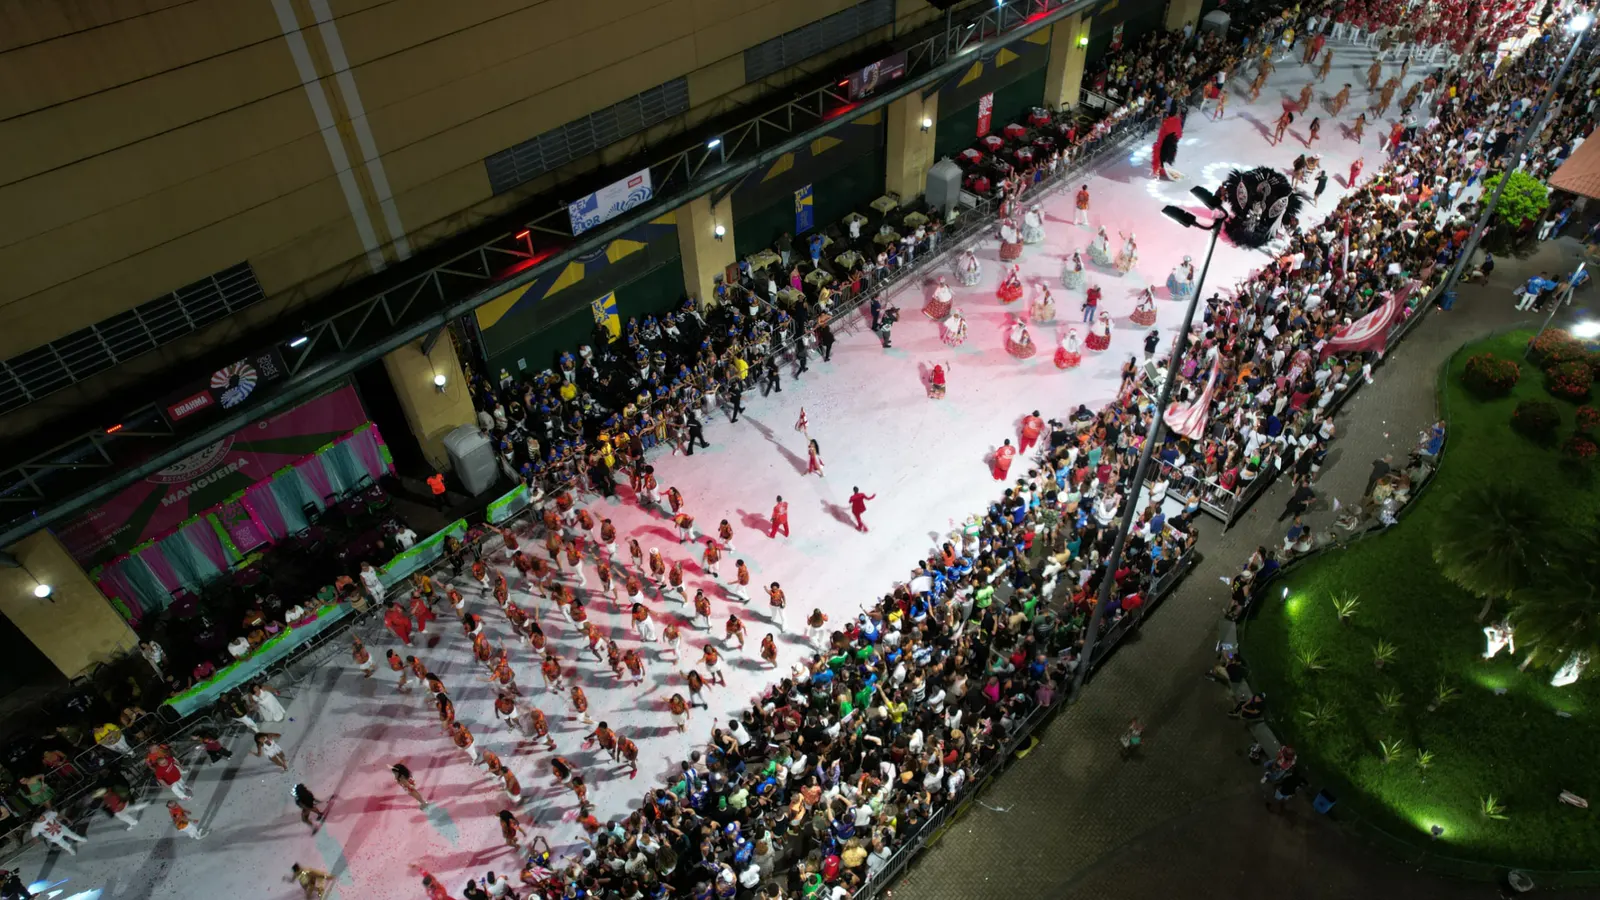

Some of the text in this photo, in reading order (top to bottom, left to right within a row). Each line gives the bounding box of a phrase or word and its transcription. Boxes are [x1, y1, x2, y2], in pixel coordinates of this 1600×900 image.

[573, 215, 600, 234] FLOR
[174, 395, 208, 416] BRAHMA
[162, 447, 228, 482] ESTAÇÃO PRIMEIRA
[160, 458, 249, 507] MANGUEIRA
